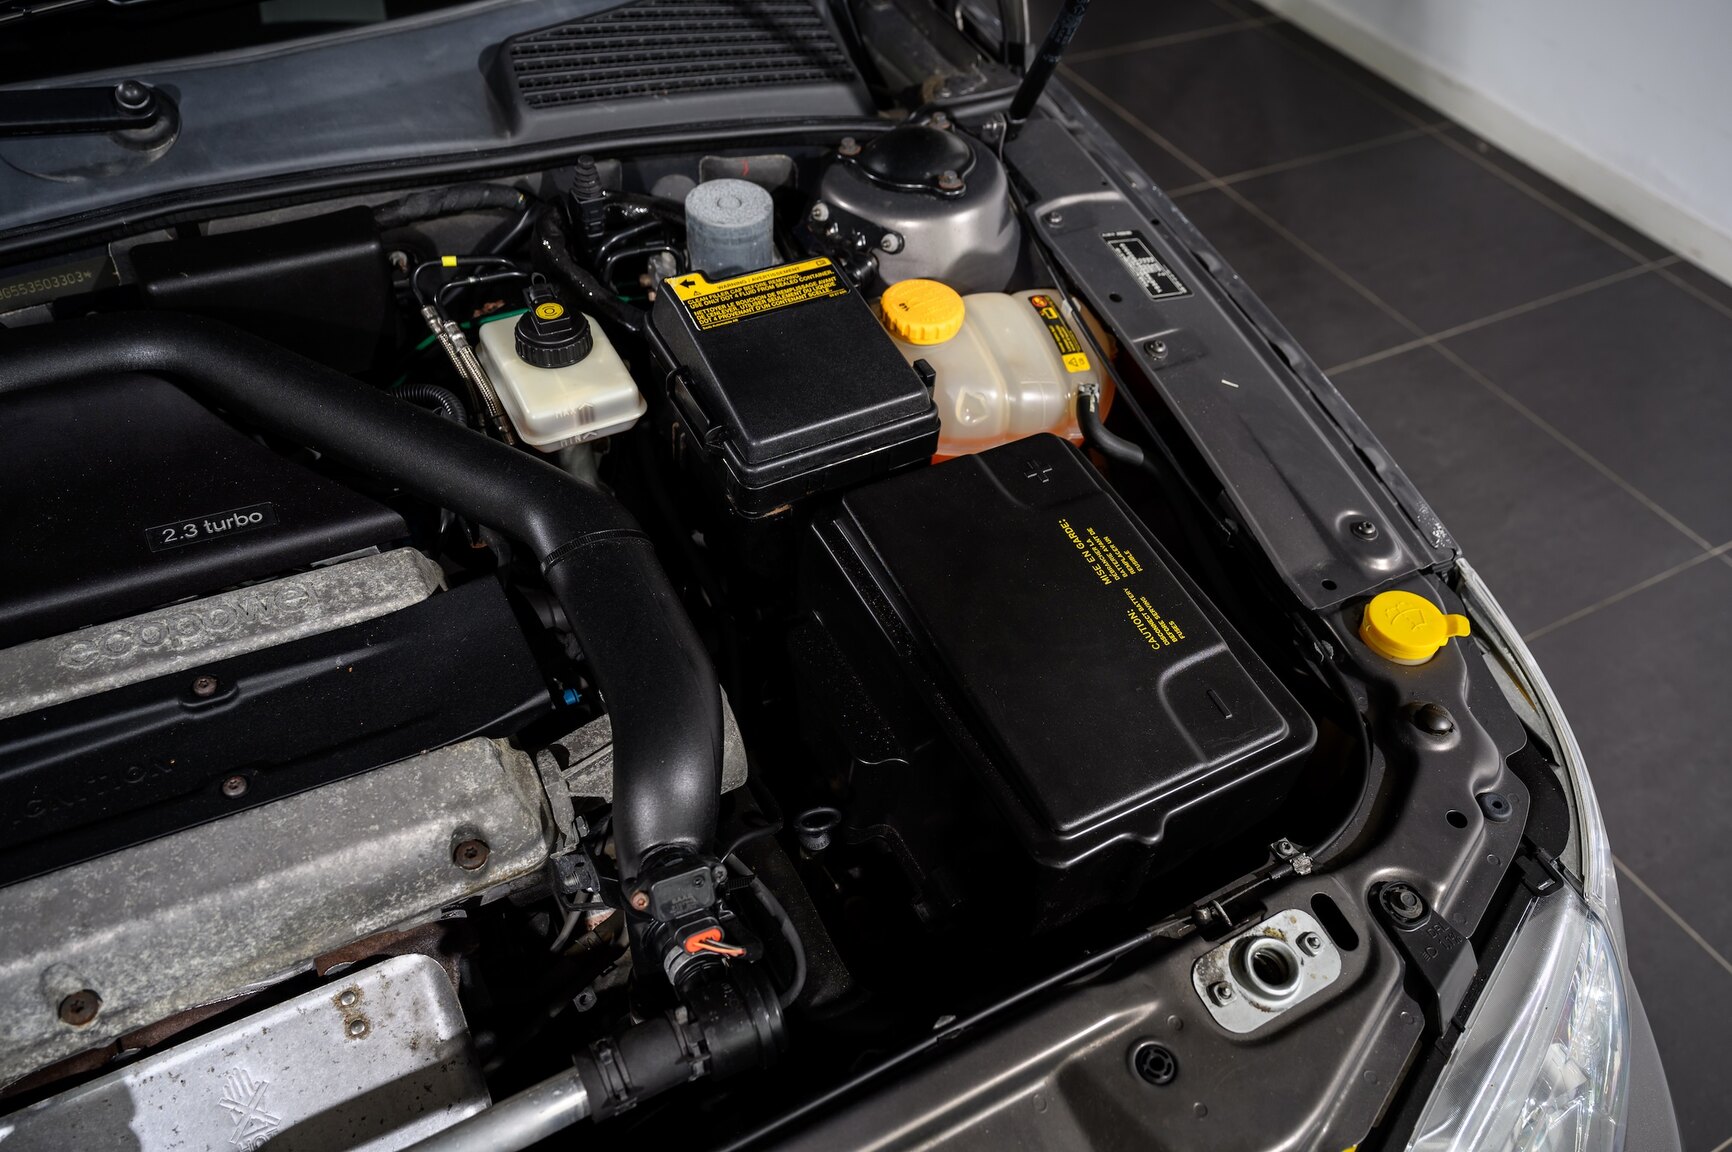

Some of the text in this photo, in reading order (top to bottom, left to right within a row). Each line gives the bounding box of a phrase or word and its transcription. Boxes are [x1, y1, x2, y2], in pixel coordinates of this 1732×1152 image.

[717, 280, 747, 290] WARNING
[751, 267, 800, 284] AVERTISSEMENT
[738, 288, 756, 297] FLUID
[756, 283, 775, 292] FROM
[774, 278, 798, 288] SEALED
[687, 296, 708, 305] CLEAN
[708, 291, 730, 299] FILLER
[743, 281, 767, 291] BEFORE
[693, 304, 726, 316] NETTOYER
[735, 294, 767, 305] BOUCHON
[776, 281, 817, 295] REMPLISSAGE
[818, 276, 836, 285] AVANT
[717, 307, 754, 319] PROVENANT
[771, 293, 806, 306] CONTENANT
[739, 299, 767, 309] UTILISER
[767, 290, 802, 302] SEULEMENT
[812, 281, 836, 291] LIQUIDE
[162, 512, 263, 543] 2.3 turbo
[1059, 519, 1112, 585] MISE EN GARDE:
[1086, 538, 1095, 547] LA
[1086, 527, 1129, 578] BATTERIE AVANT DE
[1103, 536, 1136, 575] REMPLACER UN
[1123, 549, 1143, 572] FUSIBLE
[1123, 587, 1171, 646] DISCONNECT BATTERY
[1127, 608, 1161, 650] CAUTION:
[1140, 596, 1178, 643] BEFORE SERVING
[1168, 620, 1186, 640] FUSES
[1427, 922, 1450, 939] DRL
